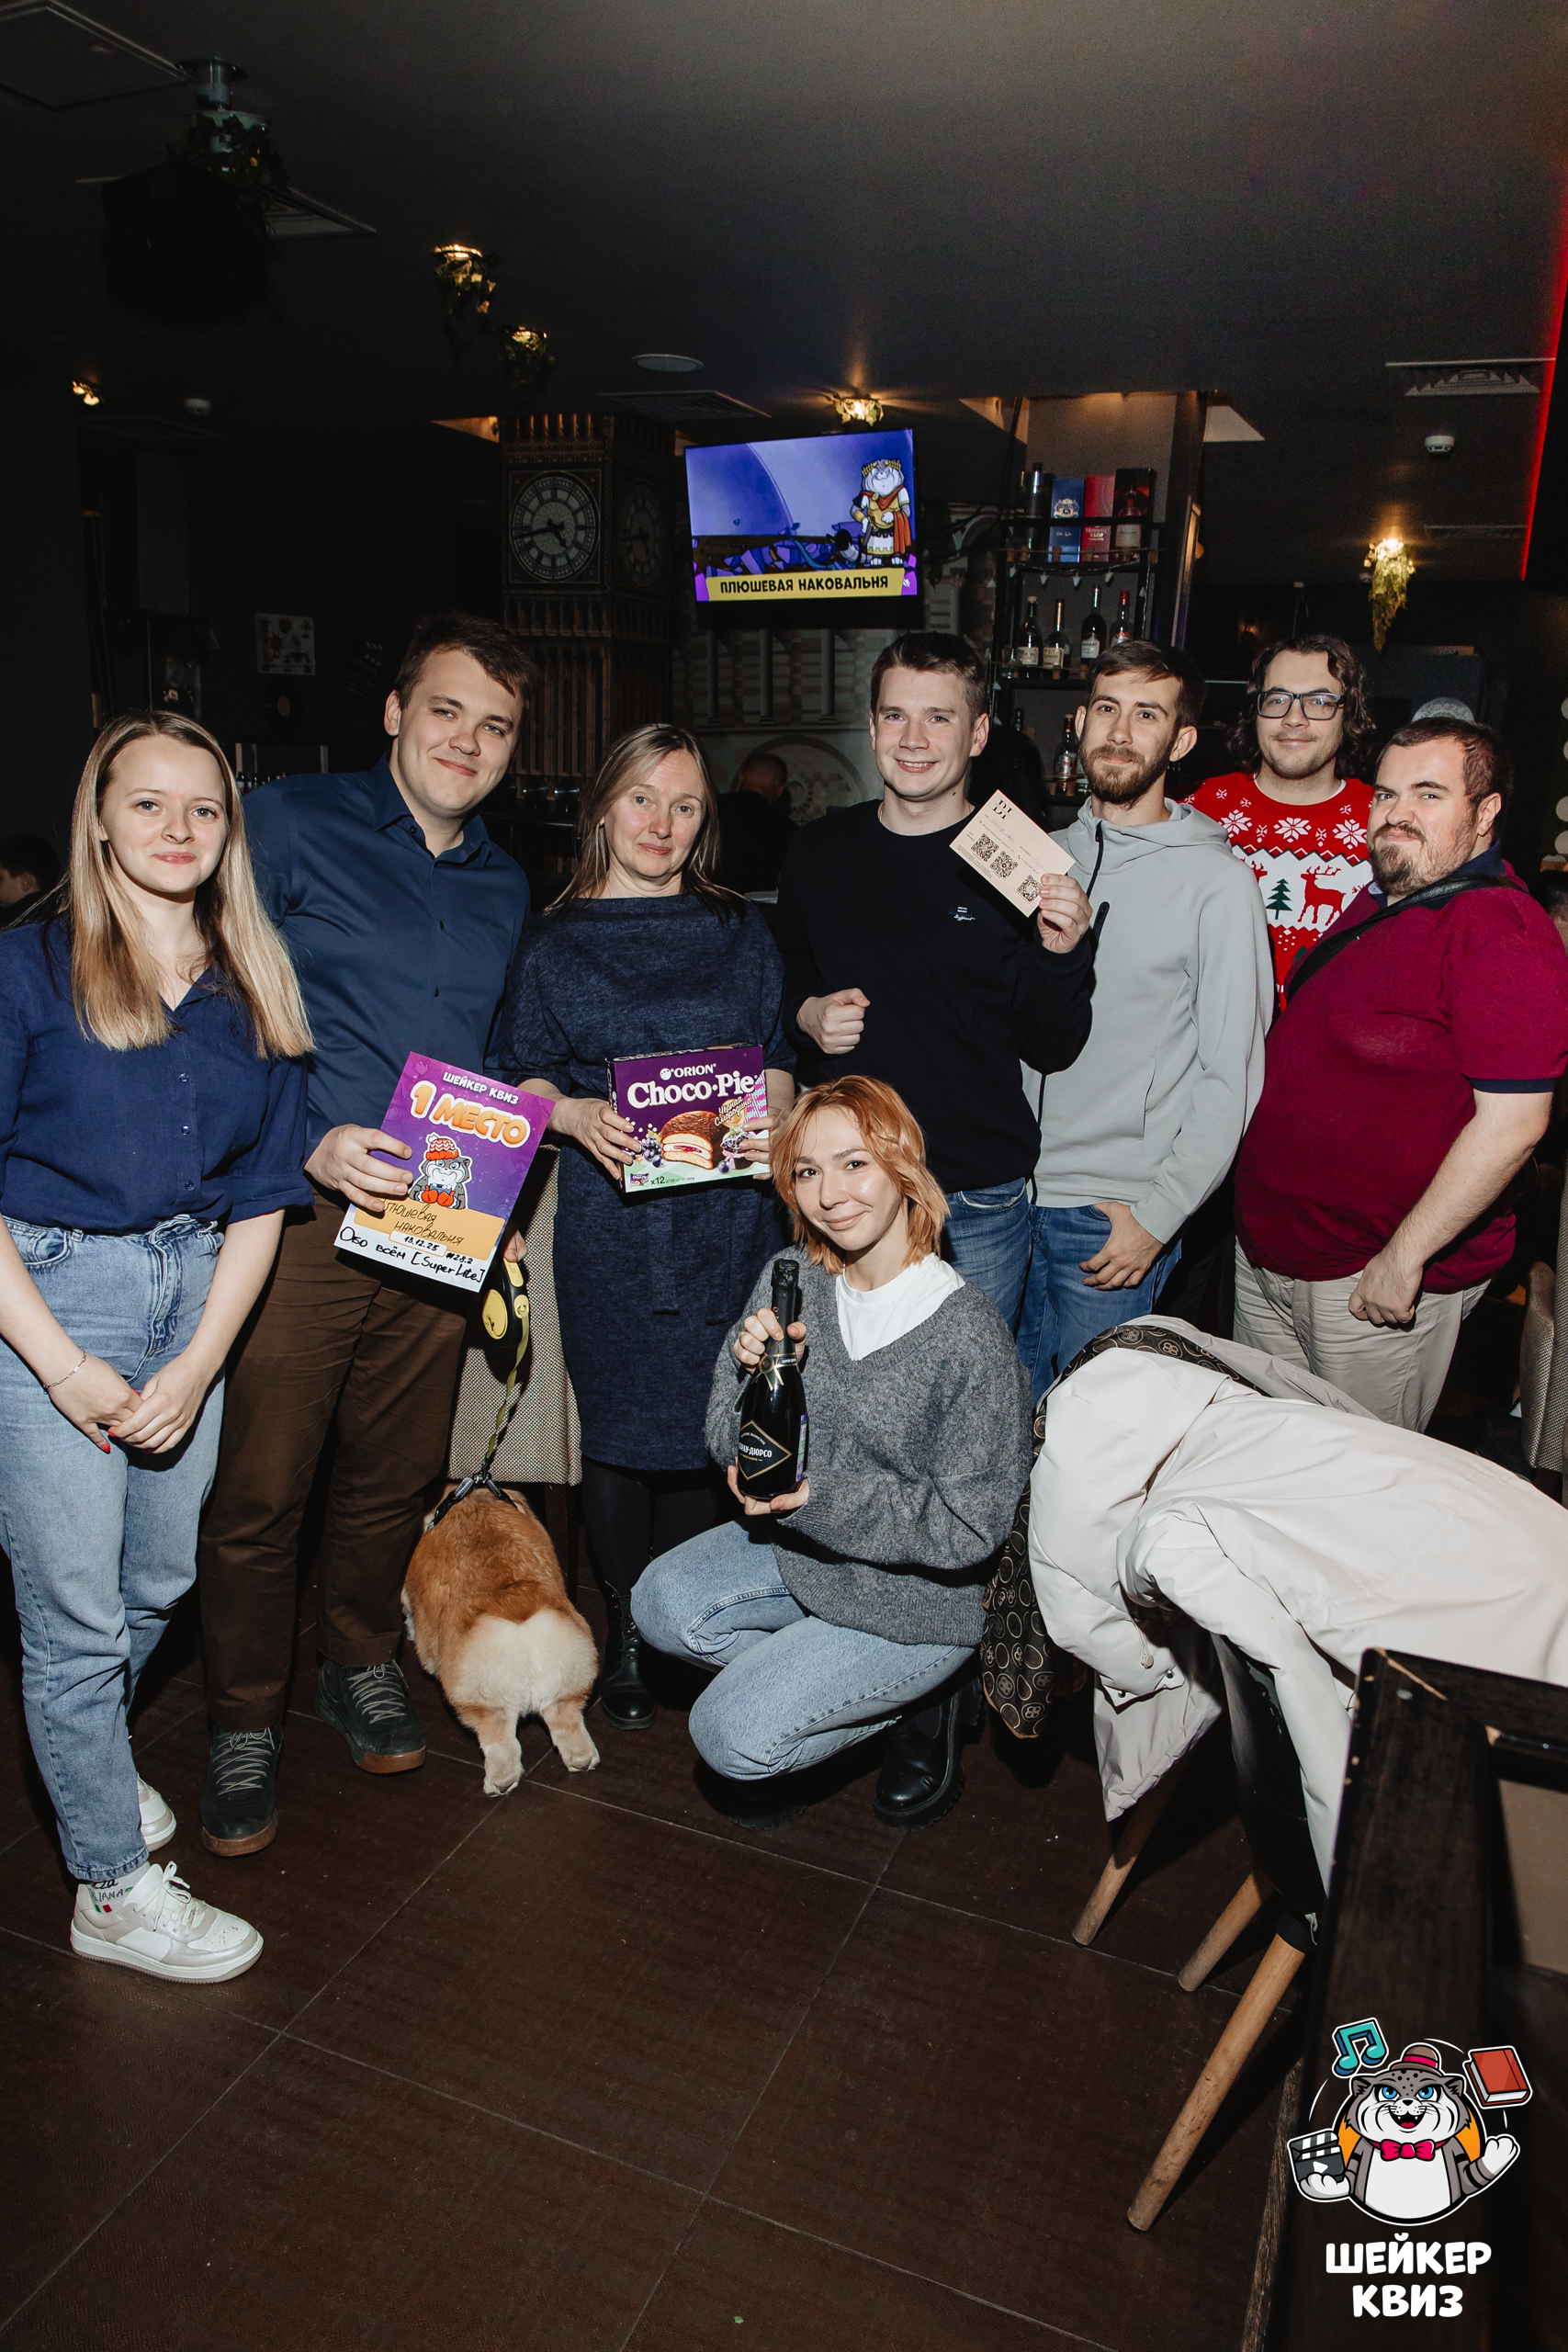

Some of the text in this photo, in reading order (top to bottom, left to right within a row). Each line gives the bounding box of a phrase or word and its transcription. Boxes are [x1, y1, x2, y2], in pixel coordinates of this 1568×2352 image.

[720, 575, 888, 594] ПЛЮШЕВАЯ НАКОВАЛЬНЯ
[673, 1064, 714, 1078] ORION
[443, 1071, 520, 1105] ШЕЙКЕР КВИЗ
[412, 1082, 528, 1146] 1 МЕСТО
[404, 1236, 441, 1252] 13.12.25
